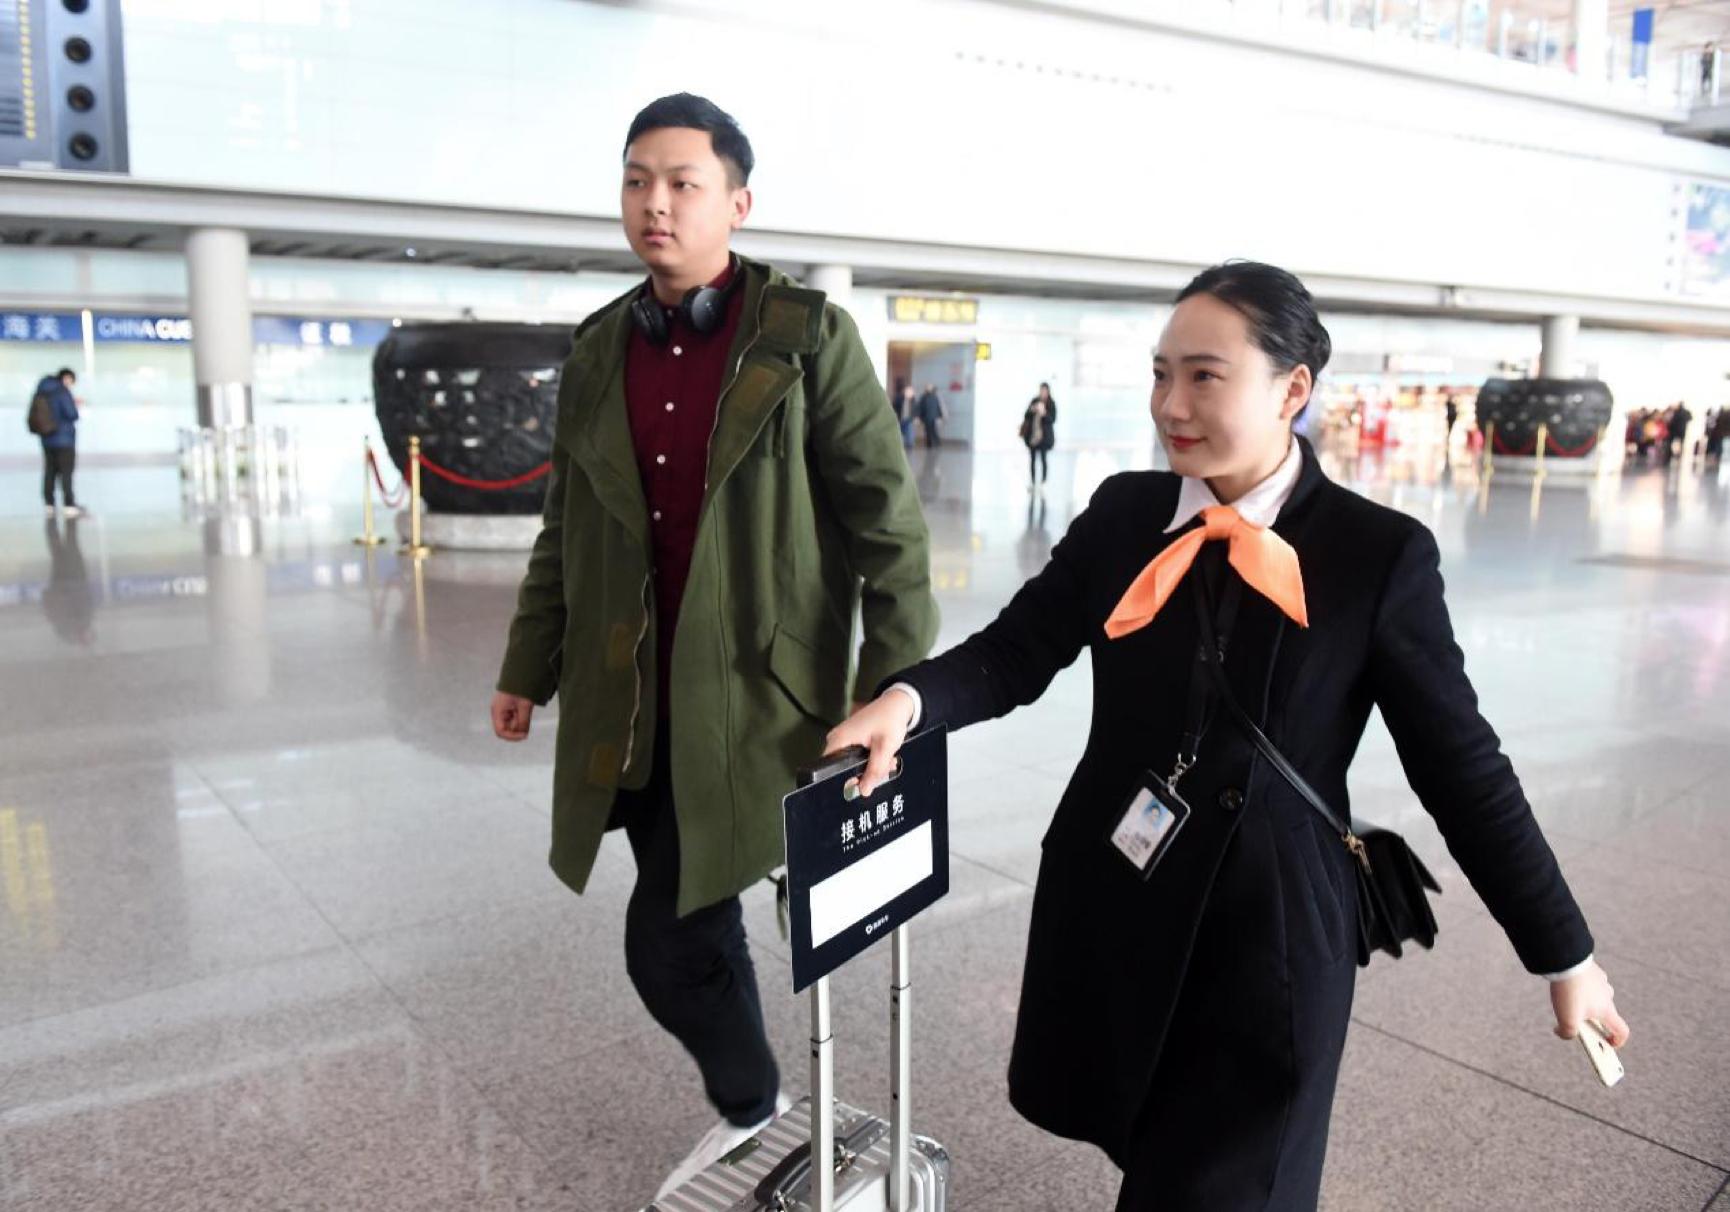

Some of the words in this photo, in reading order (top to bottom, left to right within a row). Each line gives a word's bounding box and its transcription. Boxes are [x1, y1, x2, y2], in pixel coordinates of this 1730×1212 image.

[98, 318, 155, 339] CHINA
[841, 793, 904, 844] 接机服务
